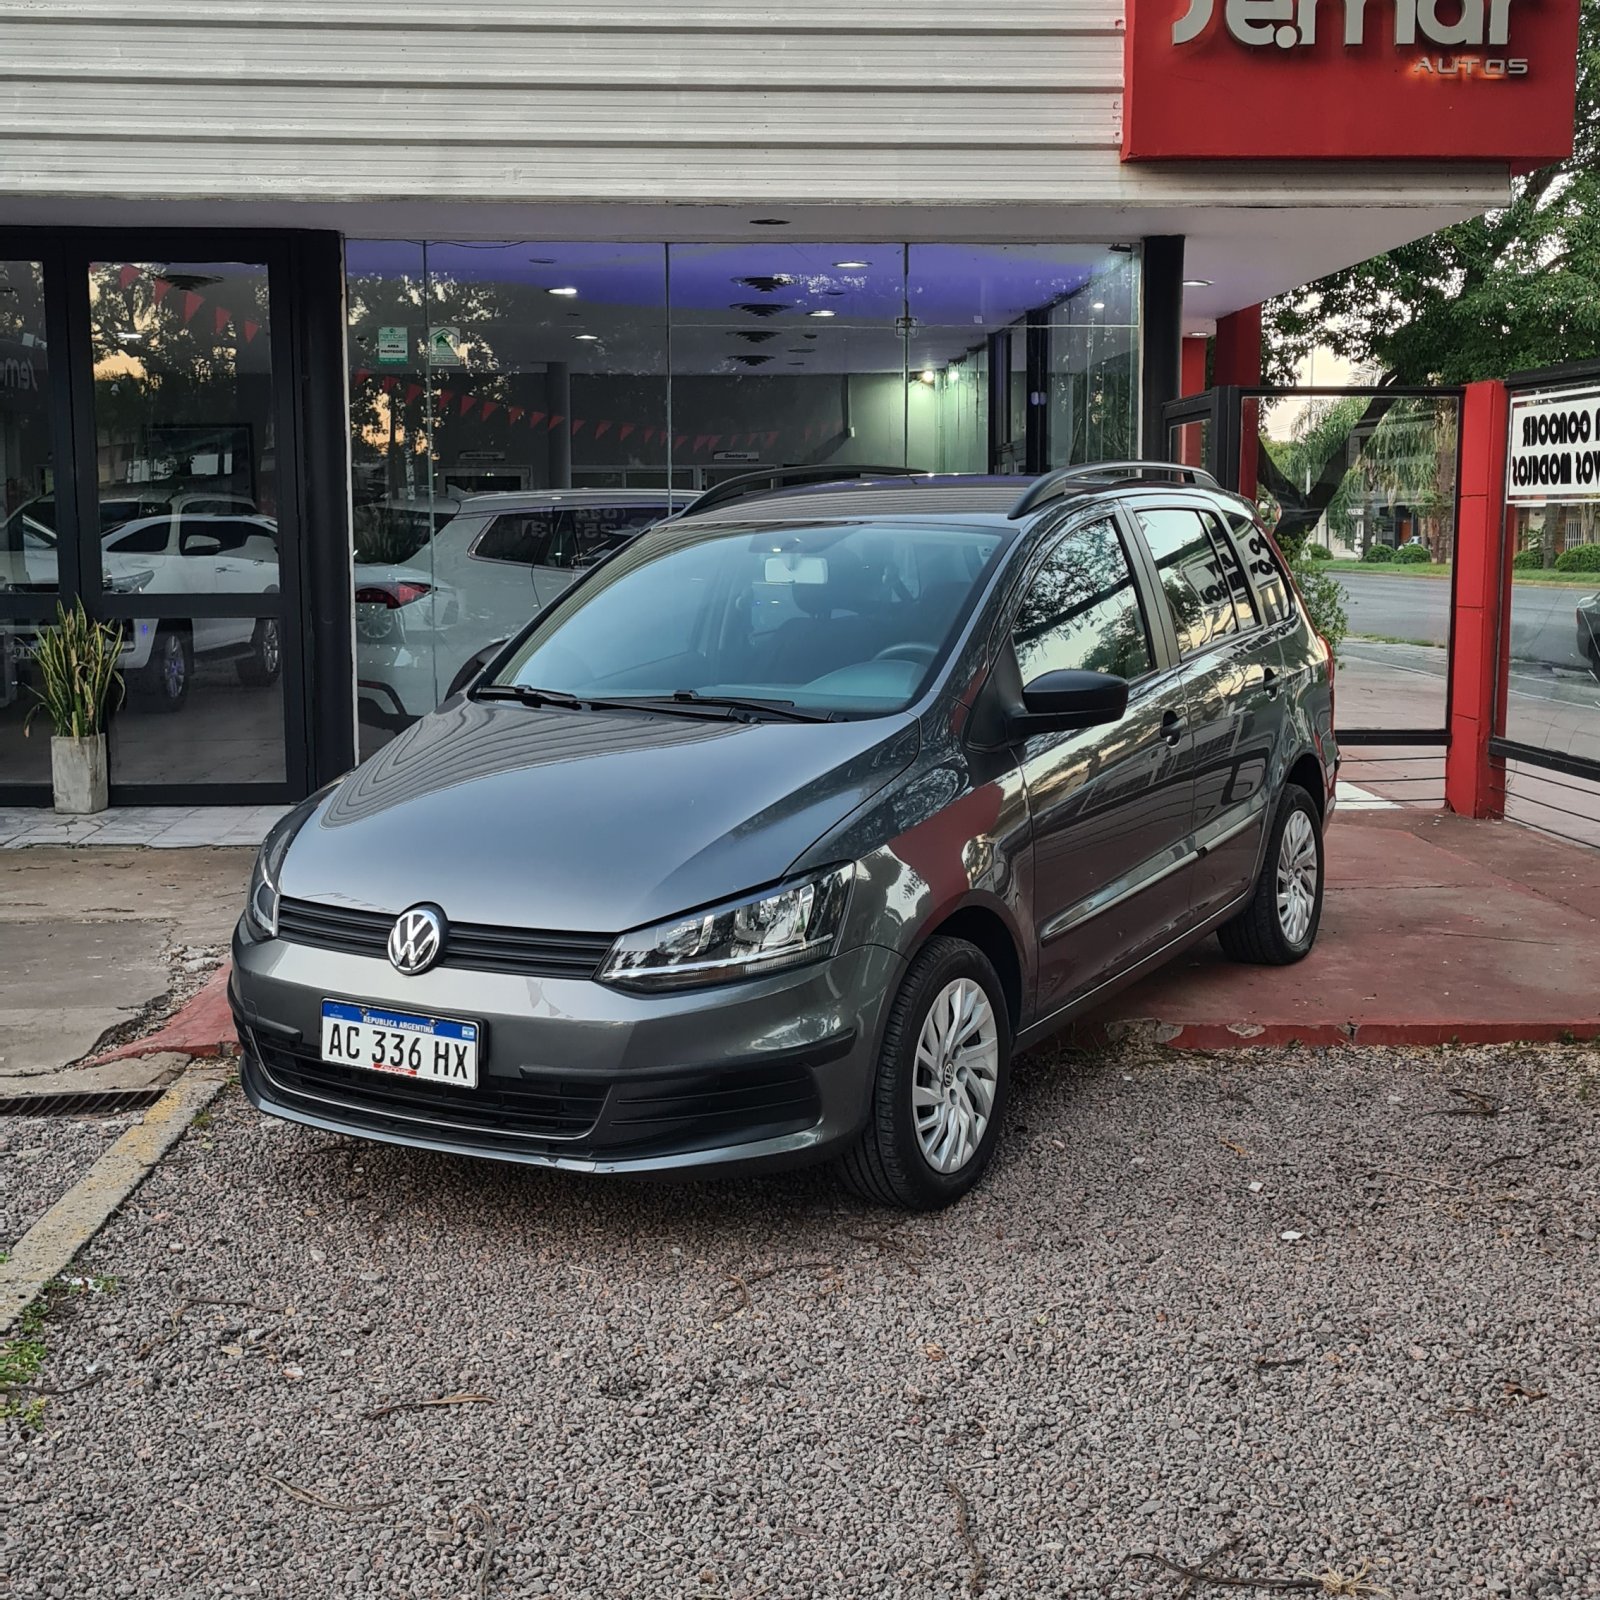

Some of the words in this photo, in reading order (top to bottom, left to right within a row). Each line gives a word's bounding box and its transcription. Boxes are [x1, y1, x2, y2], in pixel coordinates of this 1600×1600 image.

[1414, 57, 1528, 75] AUTOS
[328, 1023, 360, 1059] AC
[371, 1030, 422, 1070] 336
[433, 1040, 468, 1079] HX
